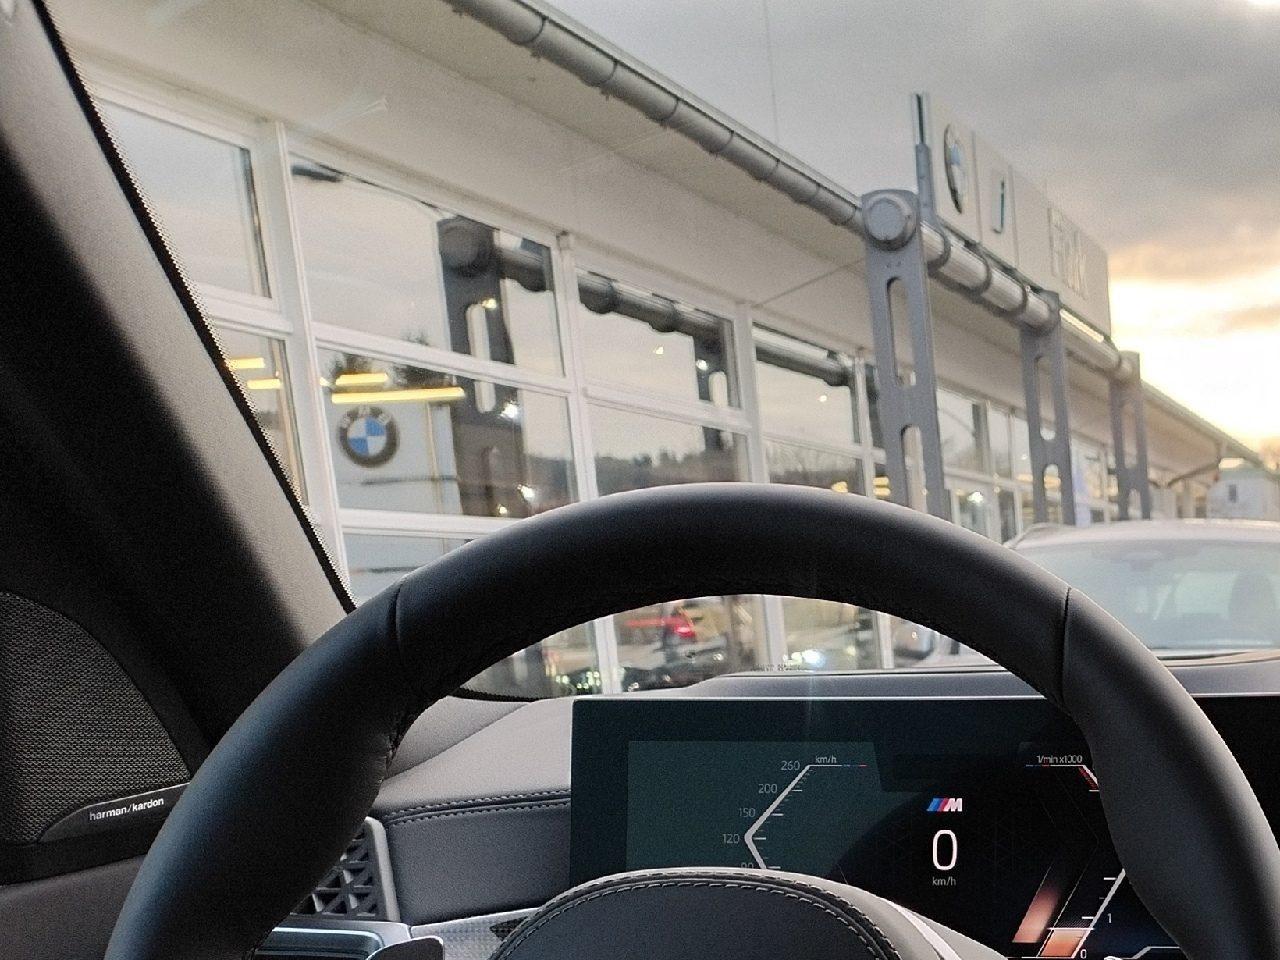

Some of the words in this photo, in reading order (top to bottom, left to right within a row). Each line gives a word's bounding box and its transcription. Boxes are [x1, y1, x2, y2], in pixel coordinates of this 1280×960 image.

[815, 755, 837, 764] km/h
[780, 760, 801, 771] 260
[758, 783, 778, 794] 200
[89, 798, 165, 821] harman/kardon
[738, 807, 756, 818] 150
[722, 833, 740, 844] 120
[932, 829, 958, 871] 0
[932, 876, 957, 886] km/h
[1080, 949, 1087, 959] 0
